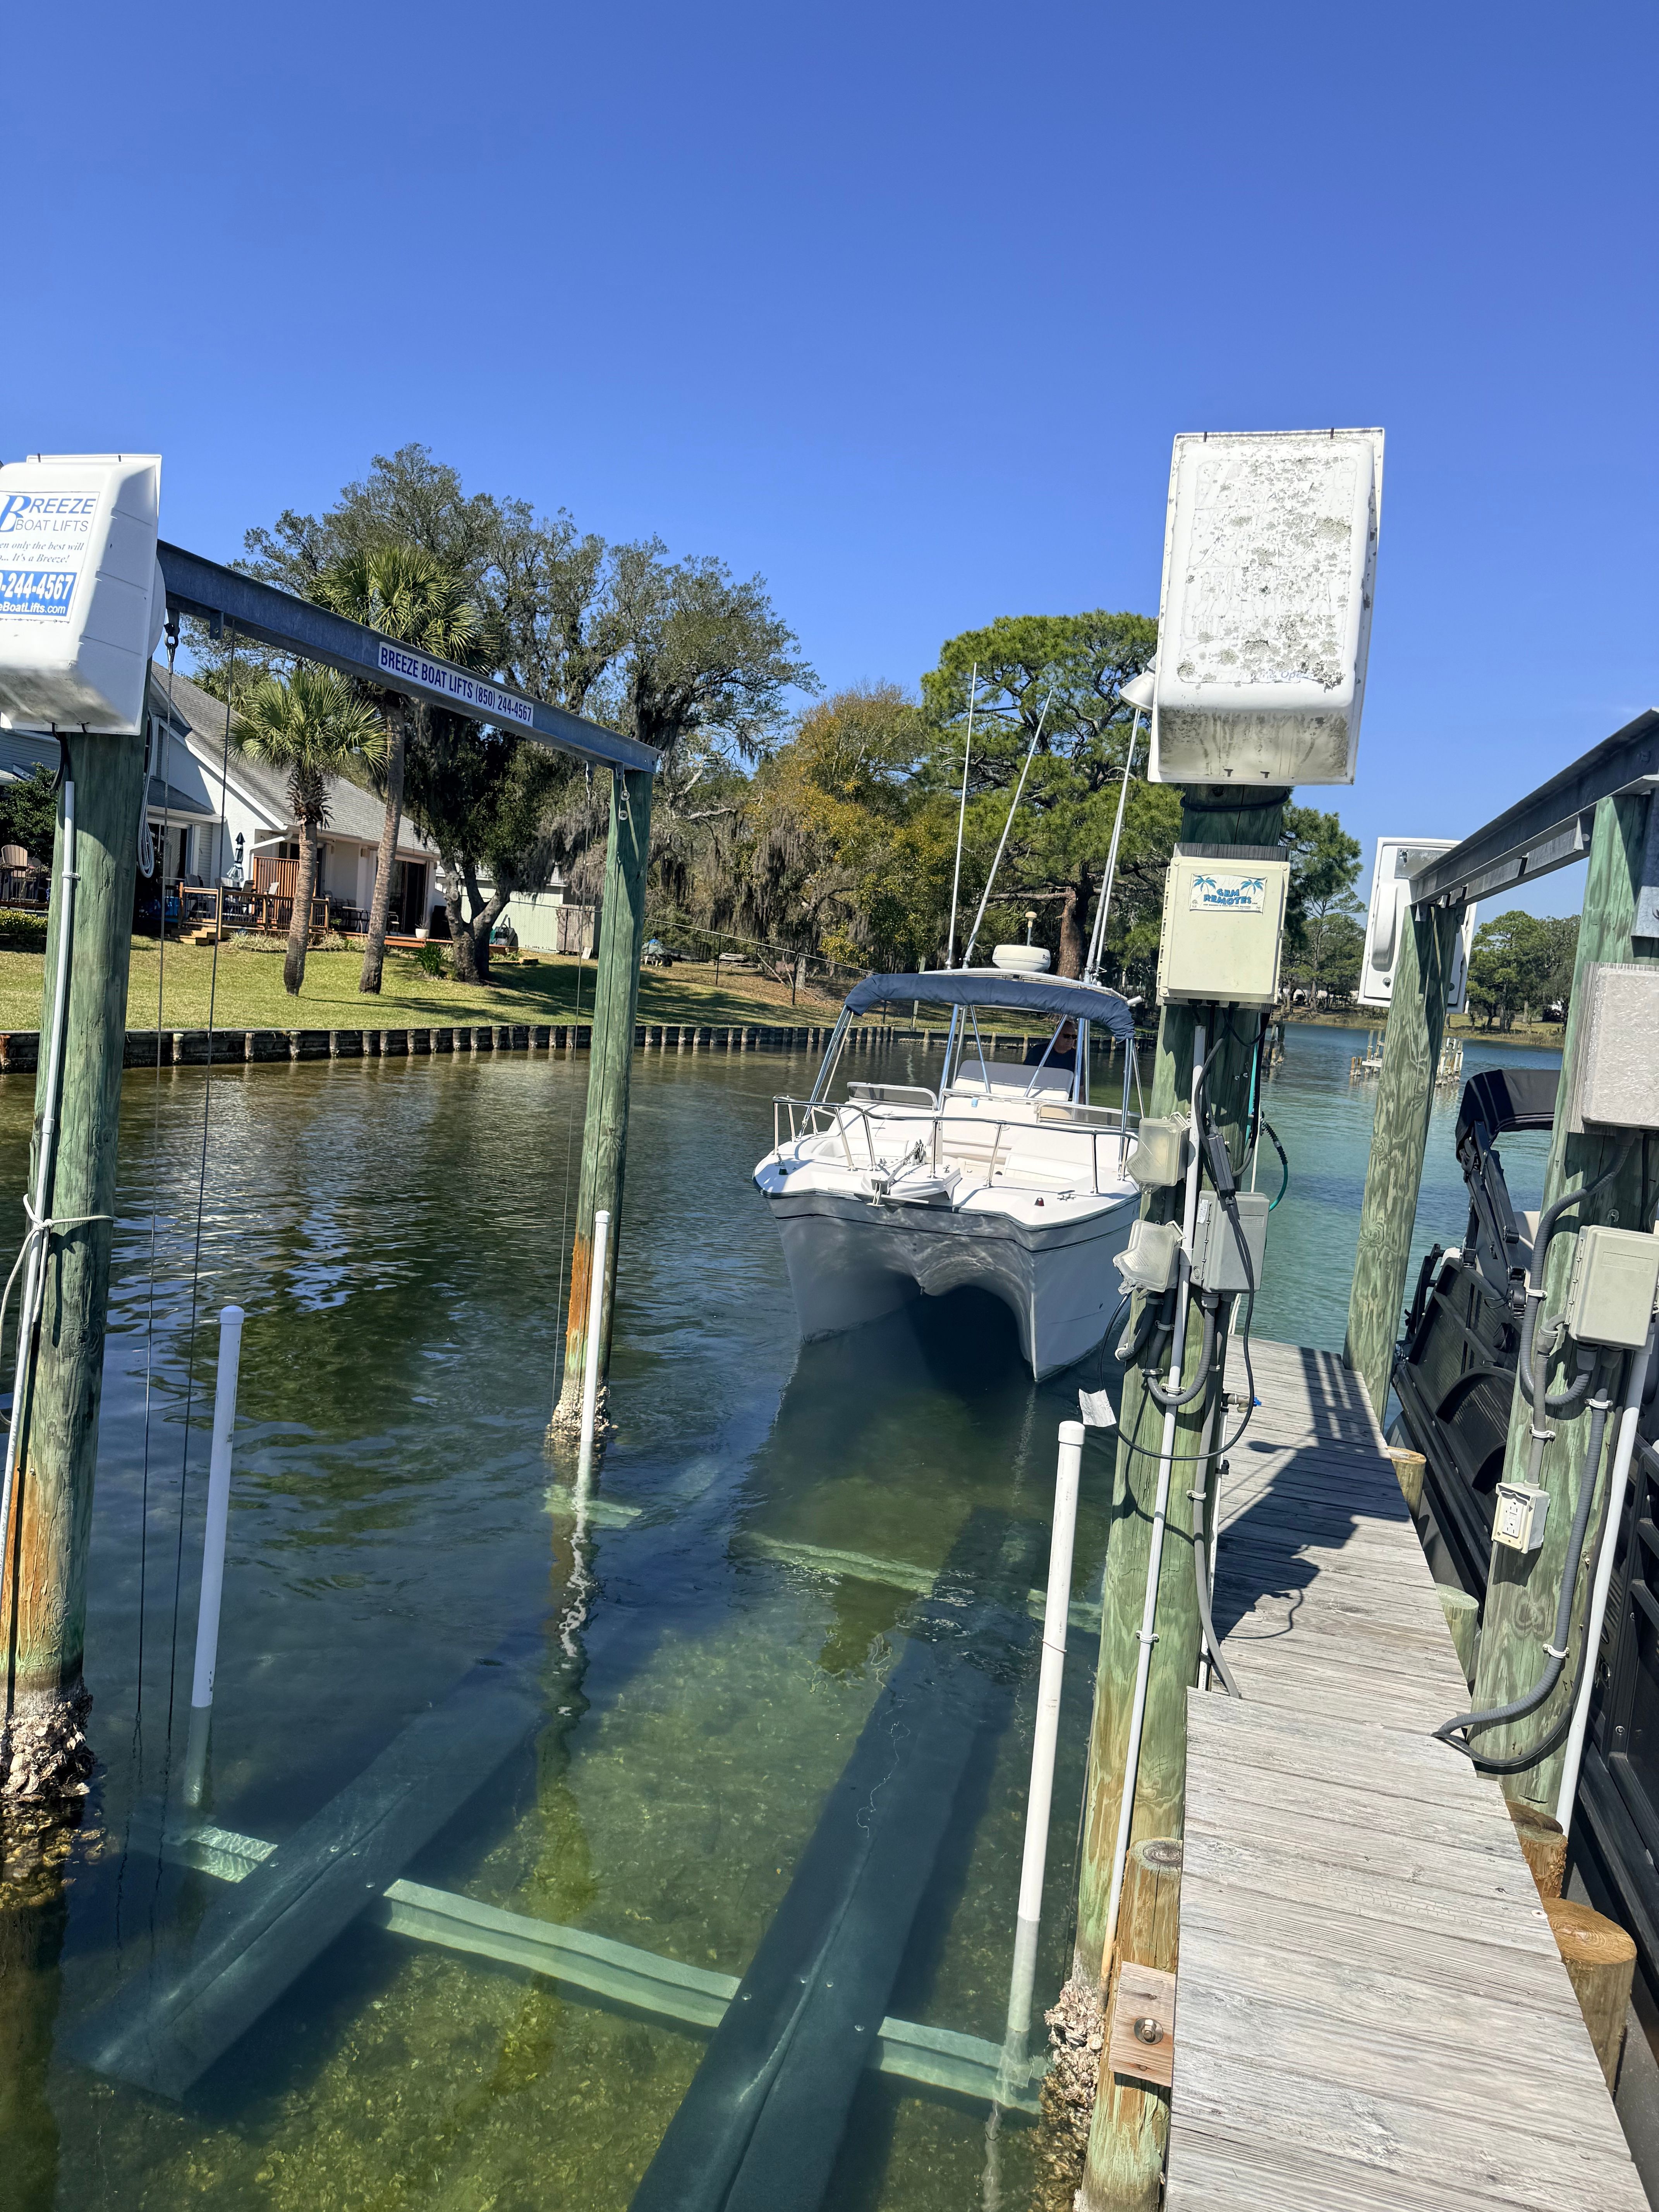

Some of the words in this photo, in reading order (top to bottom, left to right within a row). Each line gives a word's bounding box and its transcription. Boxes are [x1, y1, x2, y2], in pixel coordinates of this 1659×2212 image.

[0, 495, 96, 532] BREEZE
[15, 519, 51, 531] BOAT
[53, 520, 89, 532] LIFTS
[12, 541, 31, 551] only
[32, 541, 46, 550] the
[48, 541, 66, 550] best
[68, 542, 84, 551] will
[12, 553, 26, 562] It's
[36, 553, 70, 563] Breeze!
[381, 647, 419, 678] BREEZE
[421, 663, 447, 689] BOAT
[449, 674, 473, 699] LIFTS
[475, 684, 495, 709] (850)
[498, 695, 532, 722] 244-4567
[1216, 888, 1240, 897] GEM
[1203, 894, 1252, 905] REMOTES
